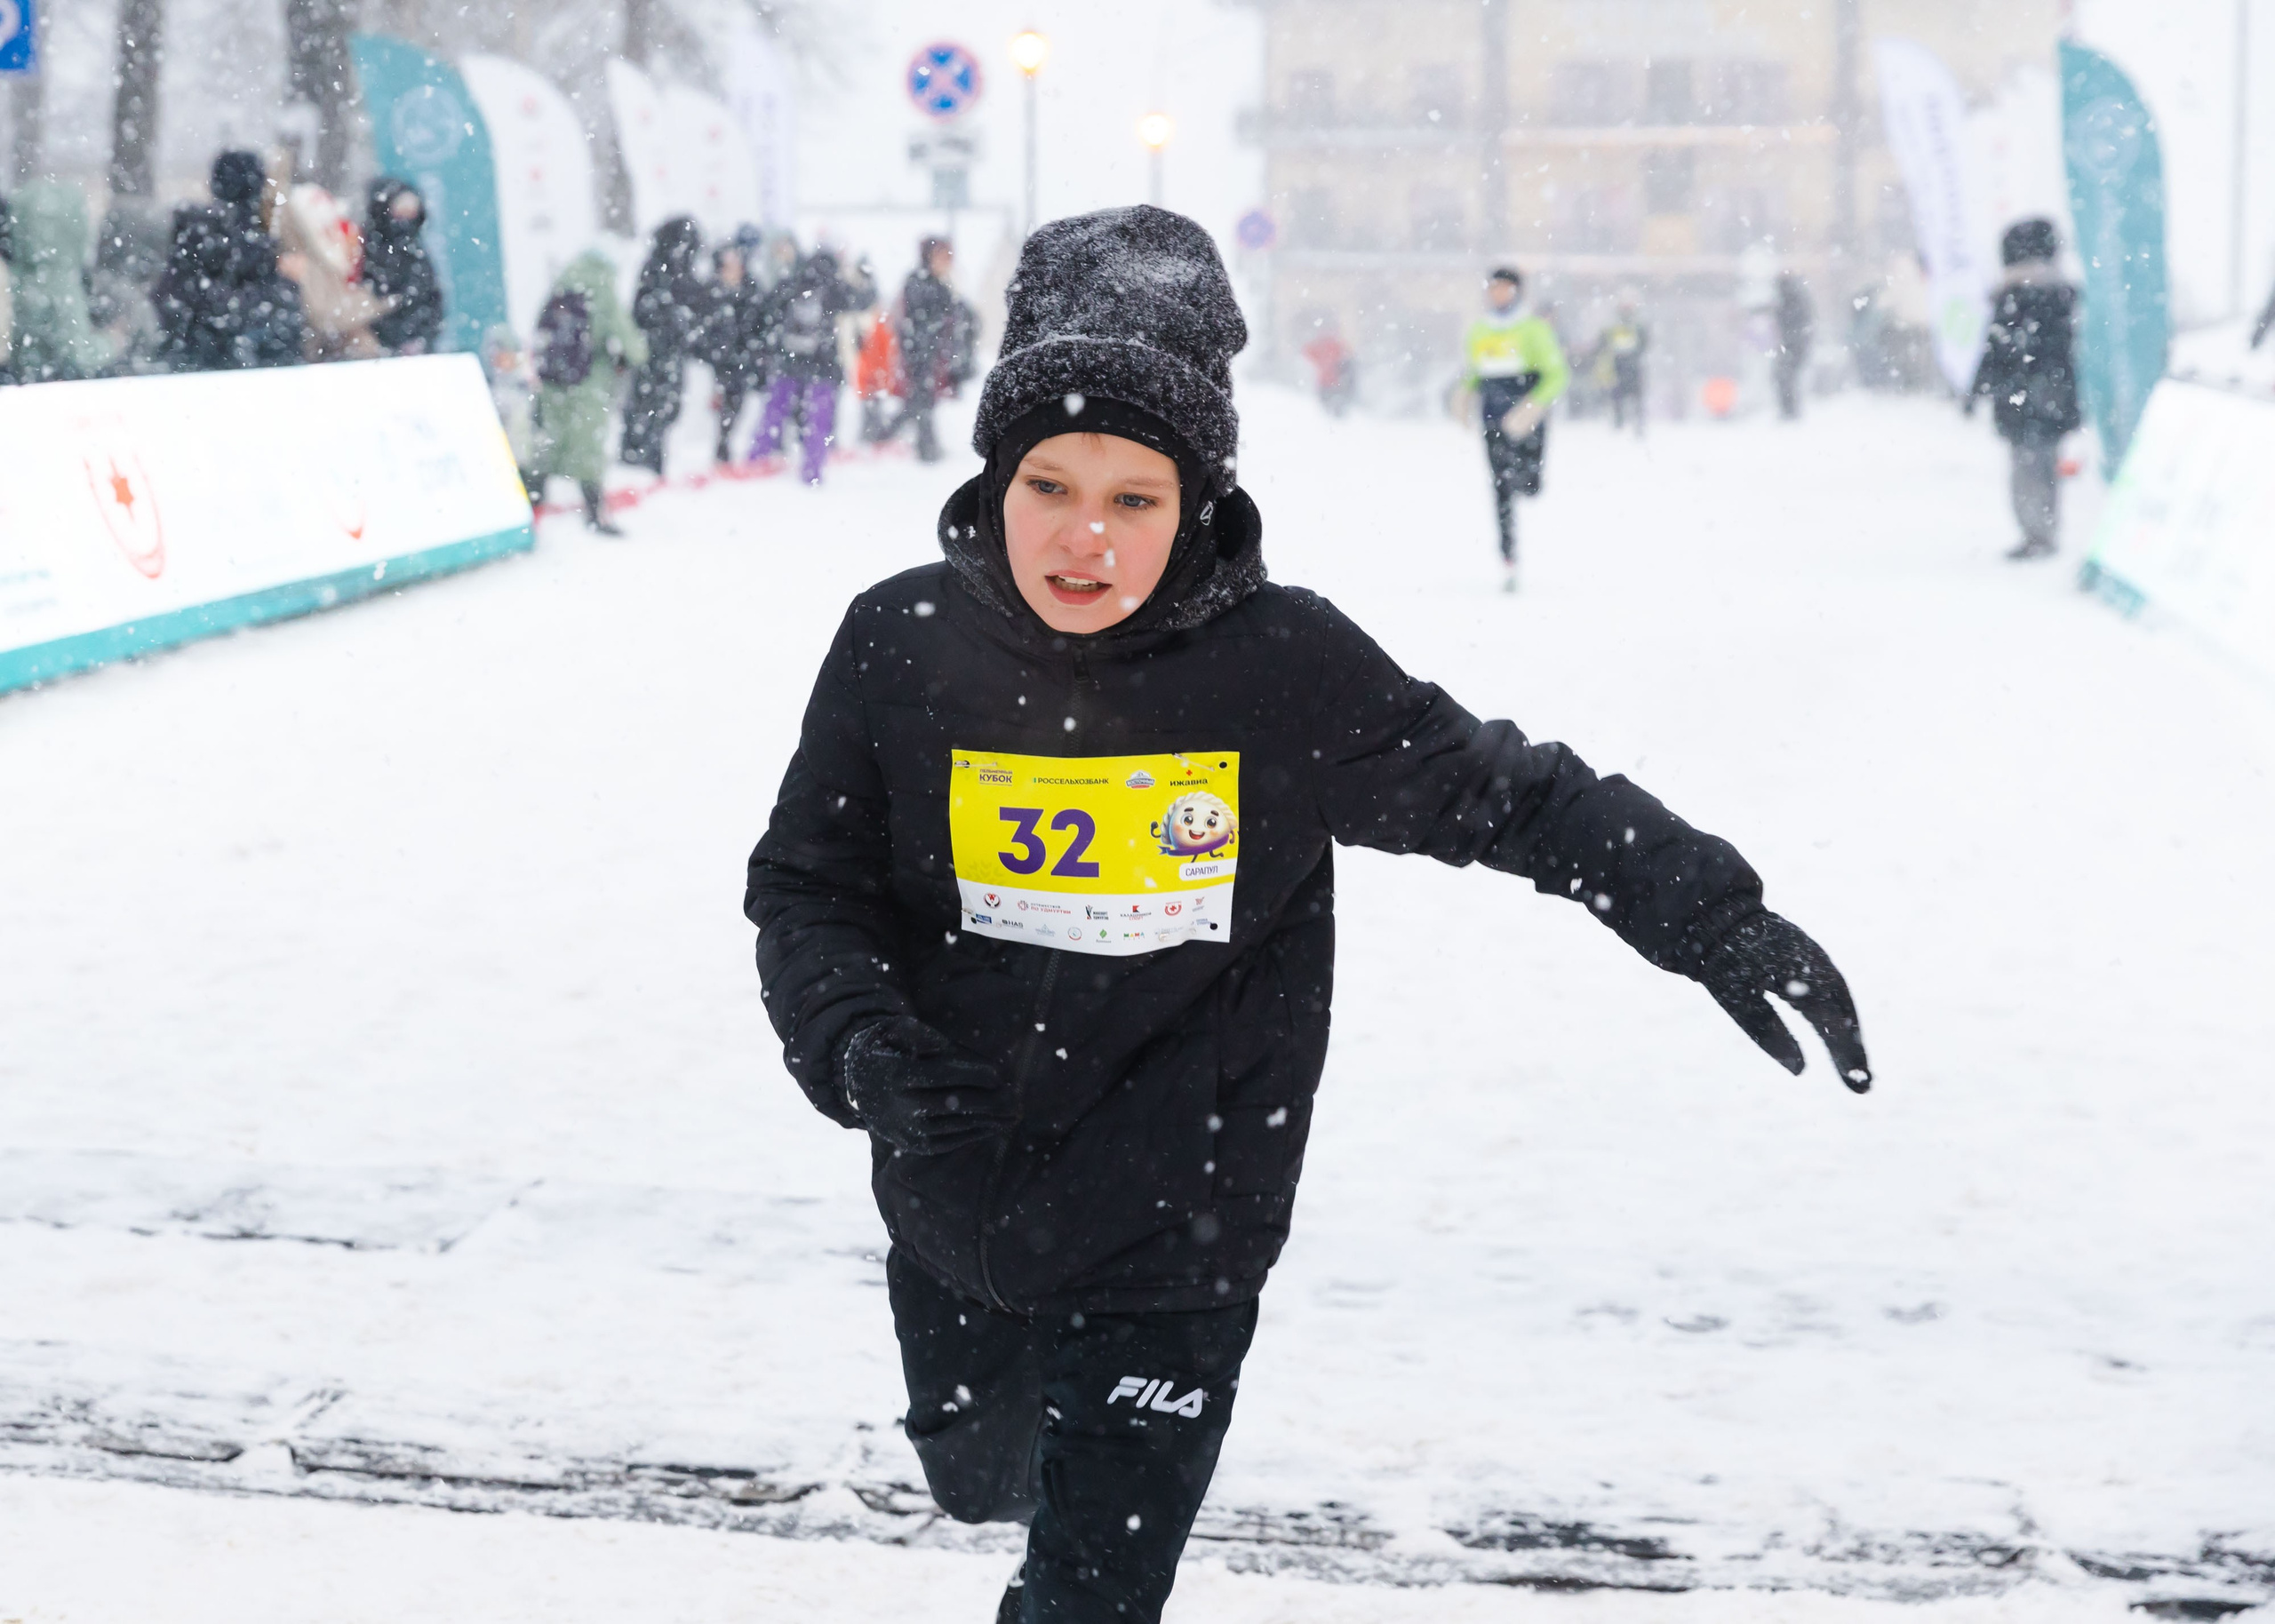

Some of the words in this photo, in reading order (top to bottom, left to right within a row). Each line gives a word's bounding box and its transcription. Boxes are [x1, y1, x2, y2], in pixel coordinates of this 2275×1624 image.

[979, 774, 1012, 784] КУБОК
[998, 807, 1099, 878] 32
[1185, 865, 1218, 876] САРАПУЛ
[1106, 1376, 1203, 1418] FILA
